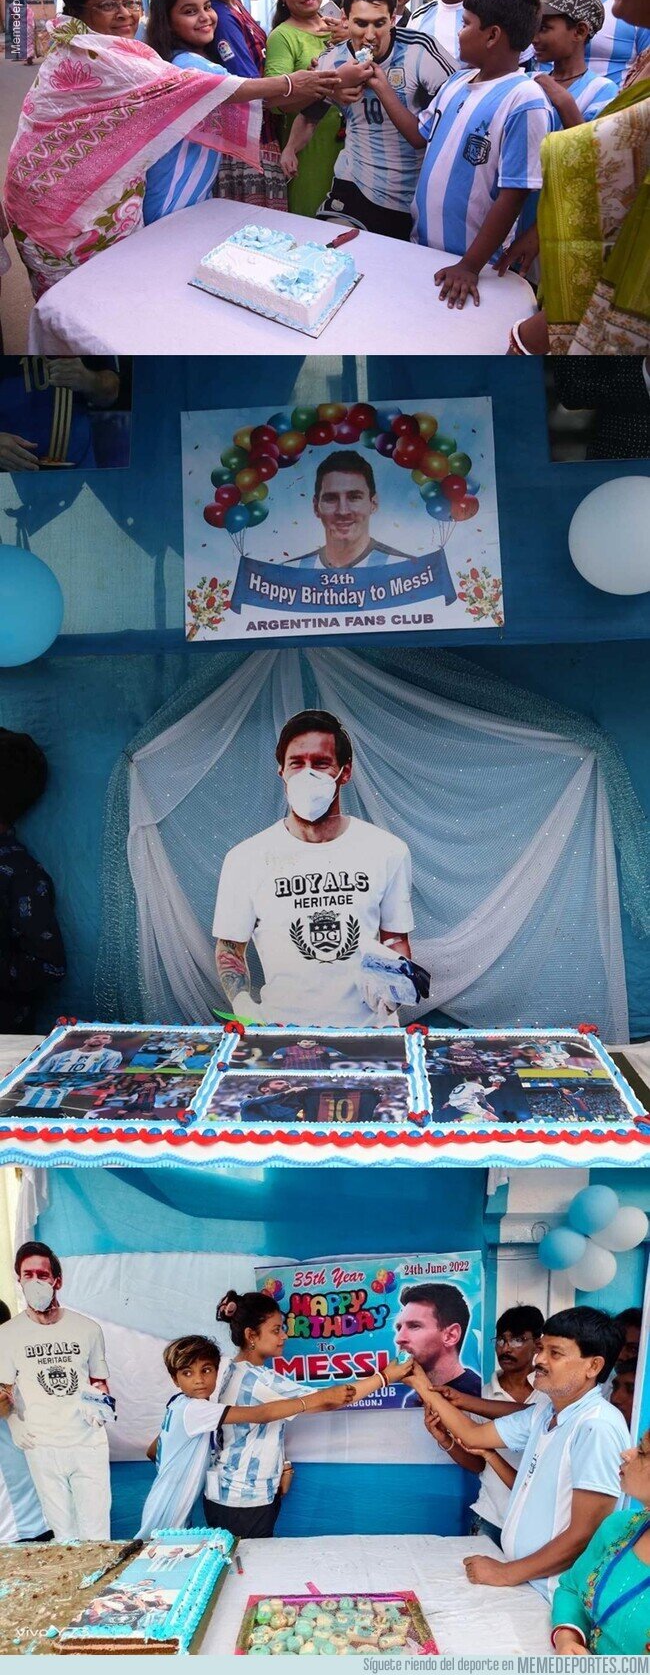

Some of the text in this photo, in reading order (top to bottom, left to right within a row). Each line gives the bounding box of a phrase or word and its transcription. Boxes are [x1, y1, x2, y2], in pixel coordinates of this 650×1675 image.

[361, 97, 384, 125] 10
[19, 356, 49, 393] 10
[249, 565, 434, 608] Happy Birthday to Messi
[320, 574, 354, 586] 34th
[246, 613, 434, 632] ARGENTINA FANS CLUB
[275, 871, 370, 898] ROYALS
[294, 895, 353, 909] HERITAGE
[313, 930, 338, 942] DG
[68, 1063, 86, 1072] 10
[325, 1098, 354, 1122] 10
[293, 1268, 365, 1288] 35th Year
[404, 1261, 470, 1276] 24th June 2022
[290, 1289, 367, 1317] HAPPY
[25, 1342, 81, 1358] ROYALS
[37, 1356, 72, 1365] HERITAGE
